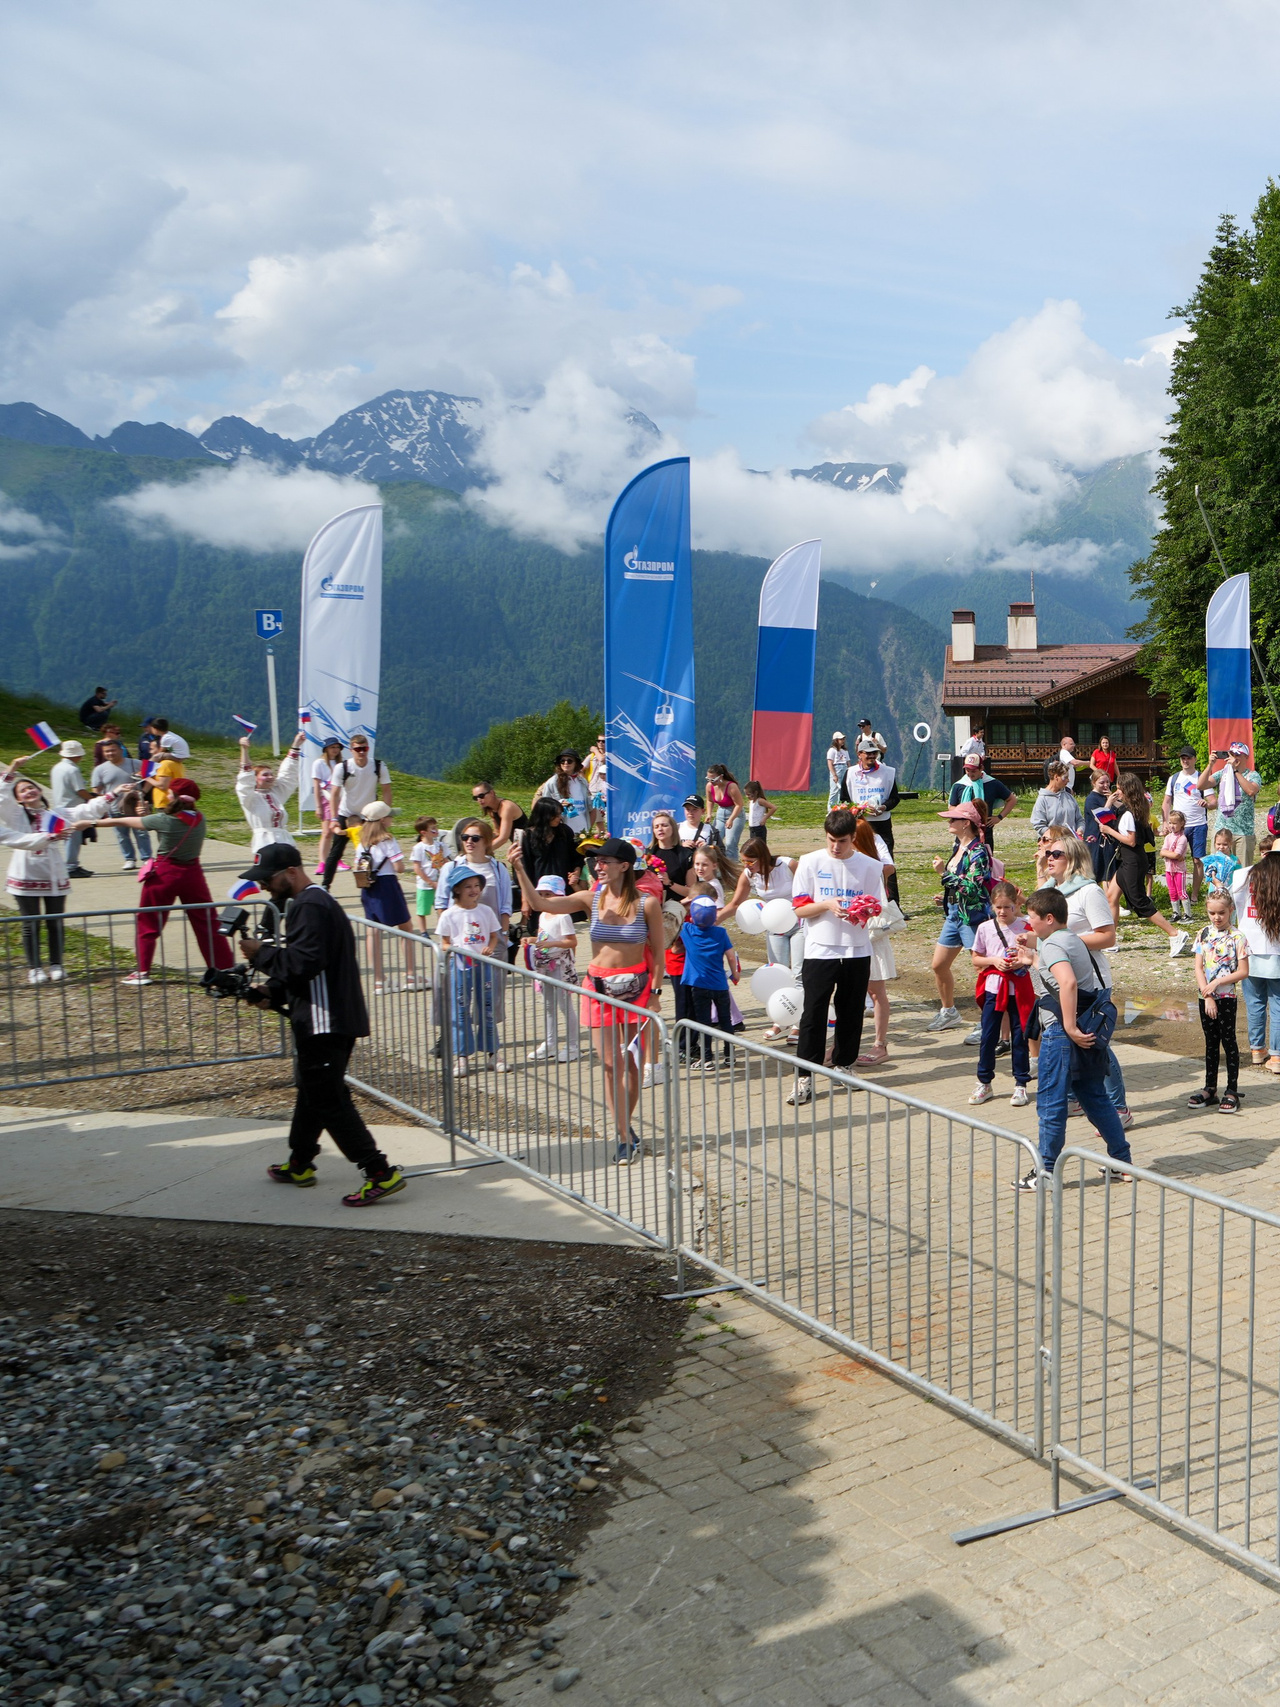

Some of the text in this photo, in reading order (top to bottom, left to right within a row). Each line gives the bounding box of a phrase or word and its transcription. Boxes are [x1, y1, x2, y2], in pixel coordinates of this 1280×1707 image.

[638, 561, 674, 571] ГАЗПРОМ
[627, 809, 677, 822] Курот
[622, 826, 652, 837] Газп
[820, 887, 834, 896] ТОТ
